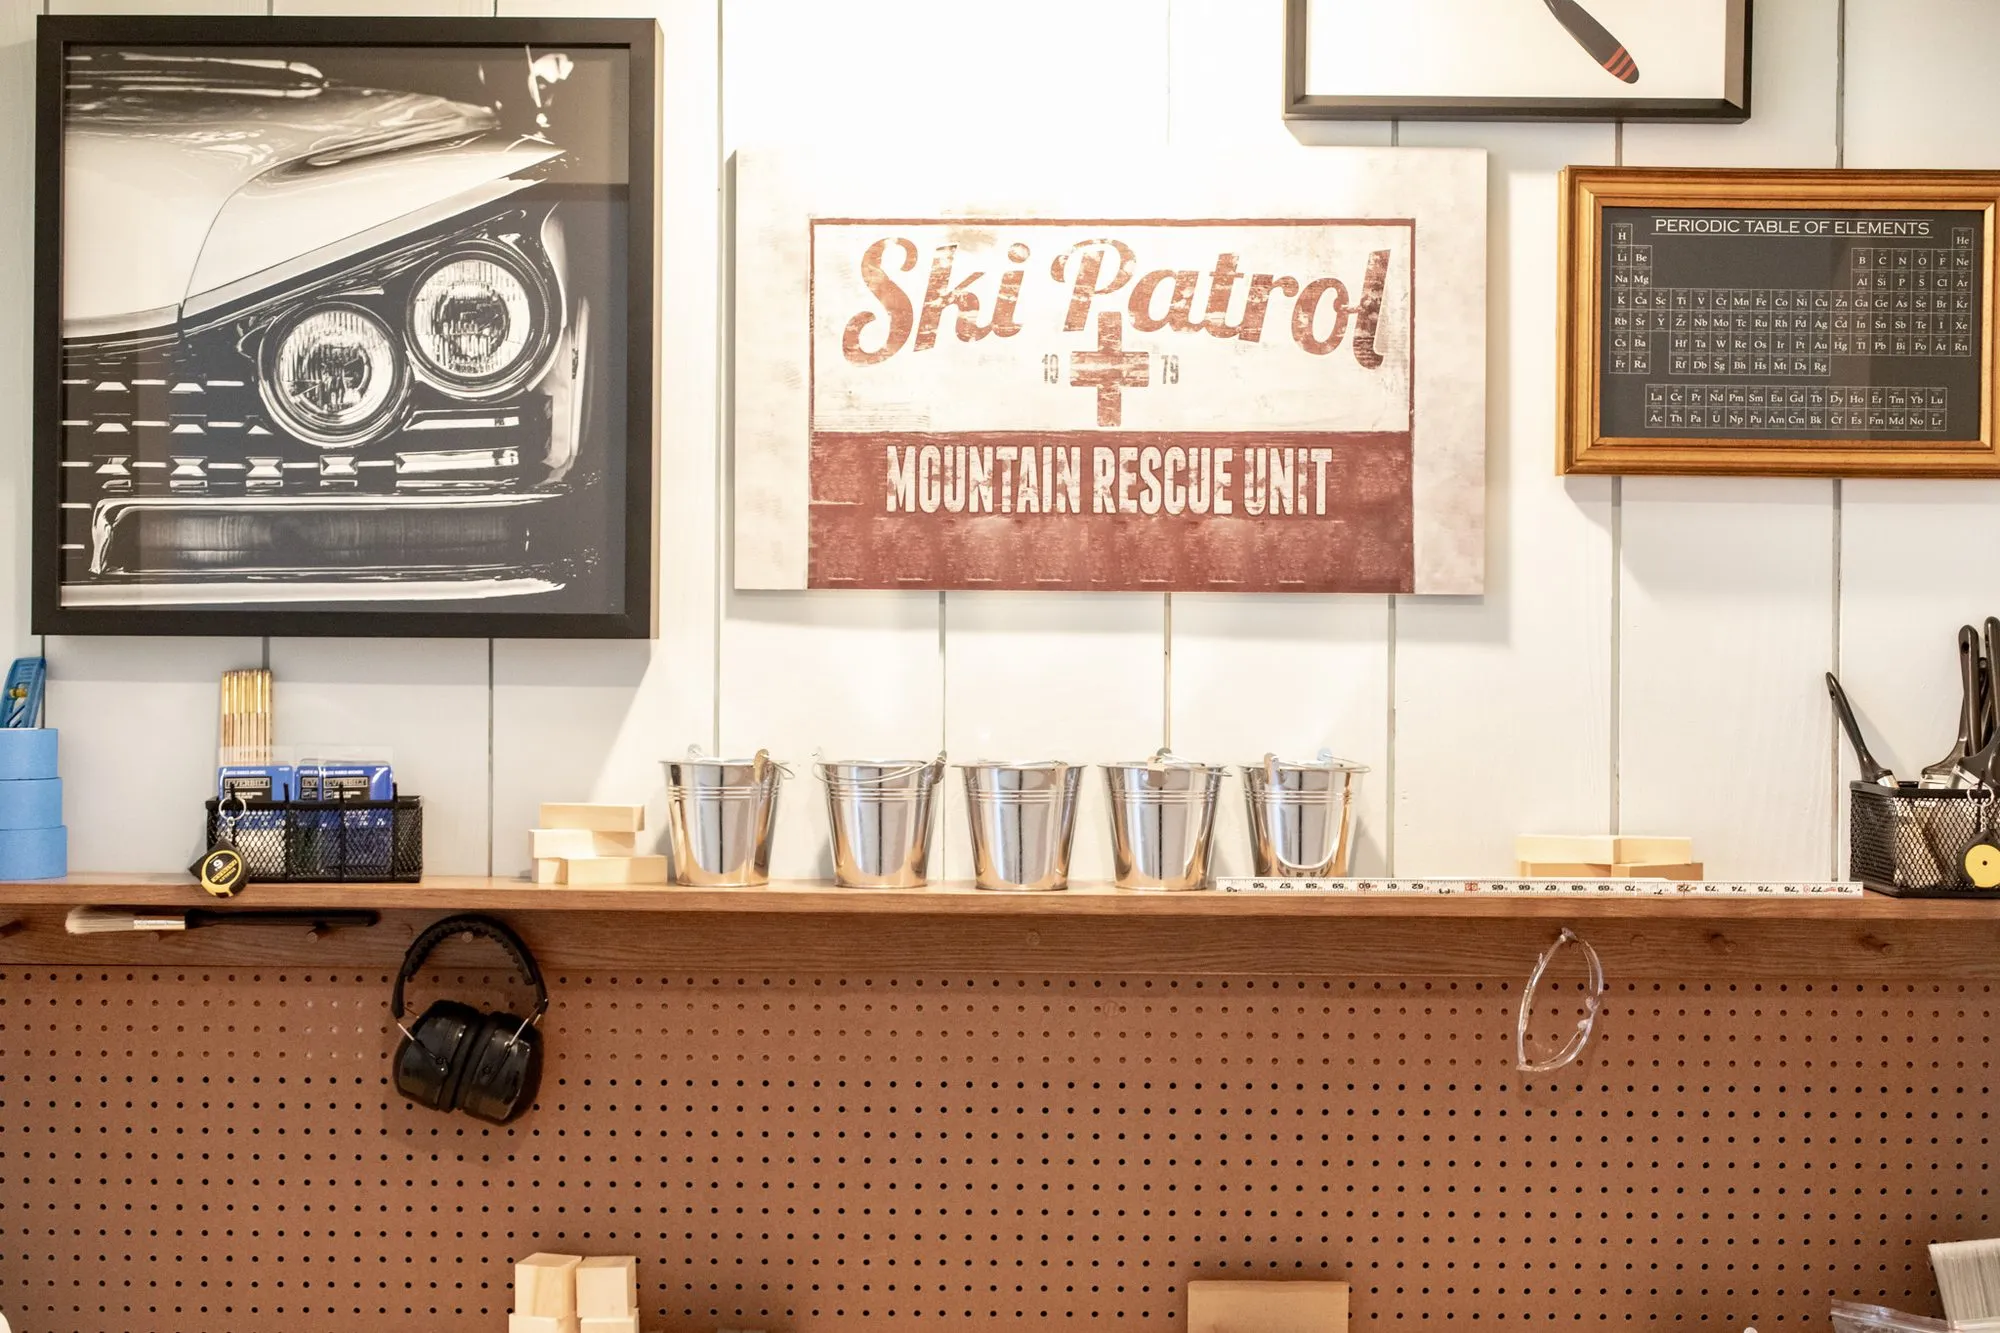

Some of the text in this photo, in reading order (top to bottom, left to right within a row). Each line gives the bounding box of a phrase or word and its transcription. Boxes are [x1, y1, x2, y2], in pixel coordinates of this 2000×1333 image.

[1655, 219, 1930, 236] PERIODIC TABLE OF ELEMENTS
[1618, 232, 1969, 245] H He
[1617, 253, 1969, 266] Li Be B C N O F Ne
[1615, 275, 1968, 287] Na Mg Al Si P S Cl Ar
[842, 237, 1392, 370] Ski Patrol
[1617, 296, 1968, 308] K Ca Sc Ti V Cr Mn Fe Co Ni Cu Zn Ga Ge As Se Br Kr
[1614, 317, 1968, 330] Rb Sr Y Zr Nb Mo Tc Ru Rh Pd Ag Cd In Sn Sb Te I Xe
[1614, 338, 1968, 352] Cs Ba Hf Ta W Re Os Ir Pt Au Hg Tl Pb Bi Po At Rn
[1041, 353, 1179, 385] 19 79
[1615, 359, 1827, 373] Fr Ra Rf Db Sg Bh Hs Mt Ds Rg
[1651, 392, 1943, 405] La Ce Pr Nd Pm Sm Eu Gd Tb Dy Ho Er Tm Yb Lu
[1650, 414, 1942, 426] Ac Th Pa U Np Pu Am Cm Bk Cf Es Fm Md No Lr
[885, 444, 1333, 517] MOUNTAIN RESCUE UNIT
